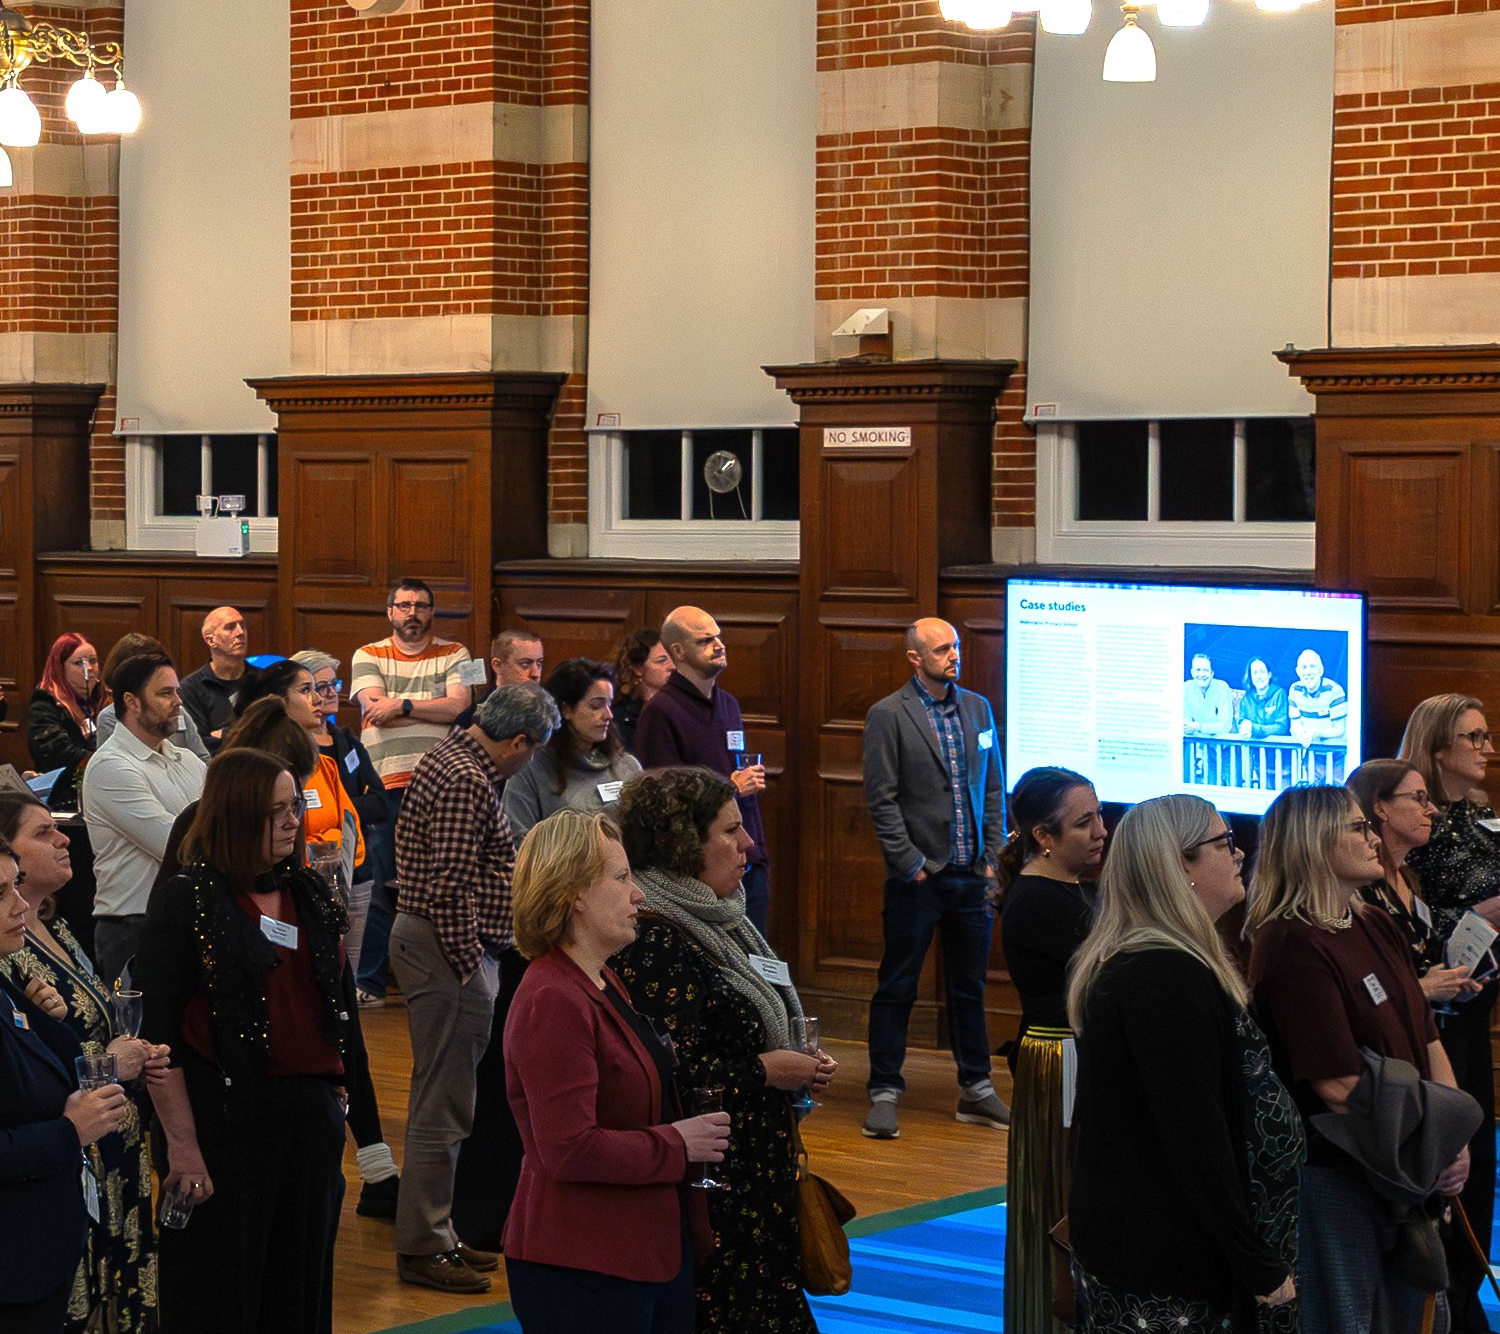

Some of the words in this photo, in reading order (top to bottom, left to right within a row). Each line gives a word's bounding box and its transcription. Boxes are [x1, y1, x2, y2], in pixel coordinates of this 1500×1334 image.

[828, 432, 847, 443] NO
[851, 431, 906, 443] SMOKING
[1020, 599, 1046, 610] Case
[1048, 601, 1086, 612] studies
